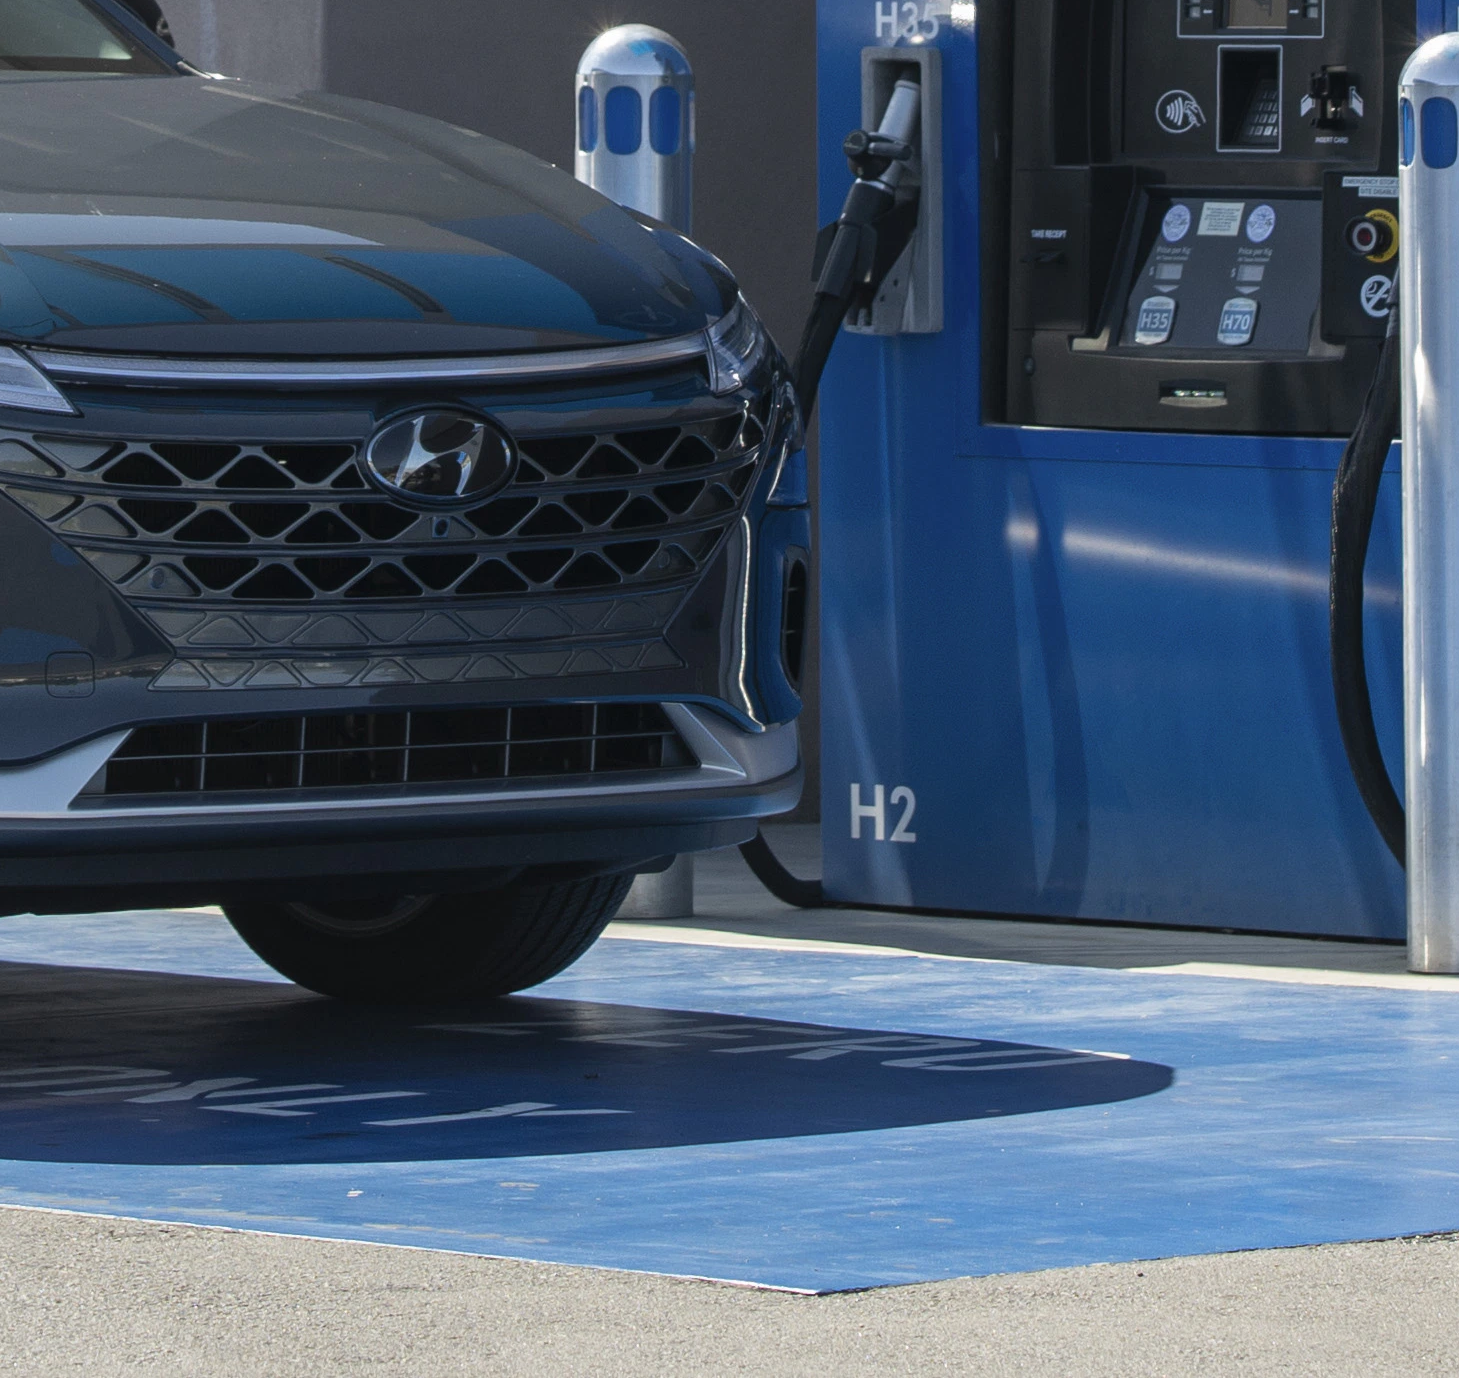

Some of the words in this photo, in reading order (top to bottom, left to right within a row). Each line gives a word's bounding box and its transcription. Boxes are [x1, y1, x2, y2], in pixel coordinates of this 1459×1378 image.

[875, 1, 940, 41] H35
[1315, 136, 1333, 144] INSERT
[1334, 136, 1349, 144] CARD
[1141, 312, 1169, 330] H35
[1222, 313, 1251, 331] H70
[851, 783, 917, 843] H2
[413, 1018, 1130, 1073] ZERO
